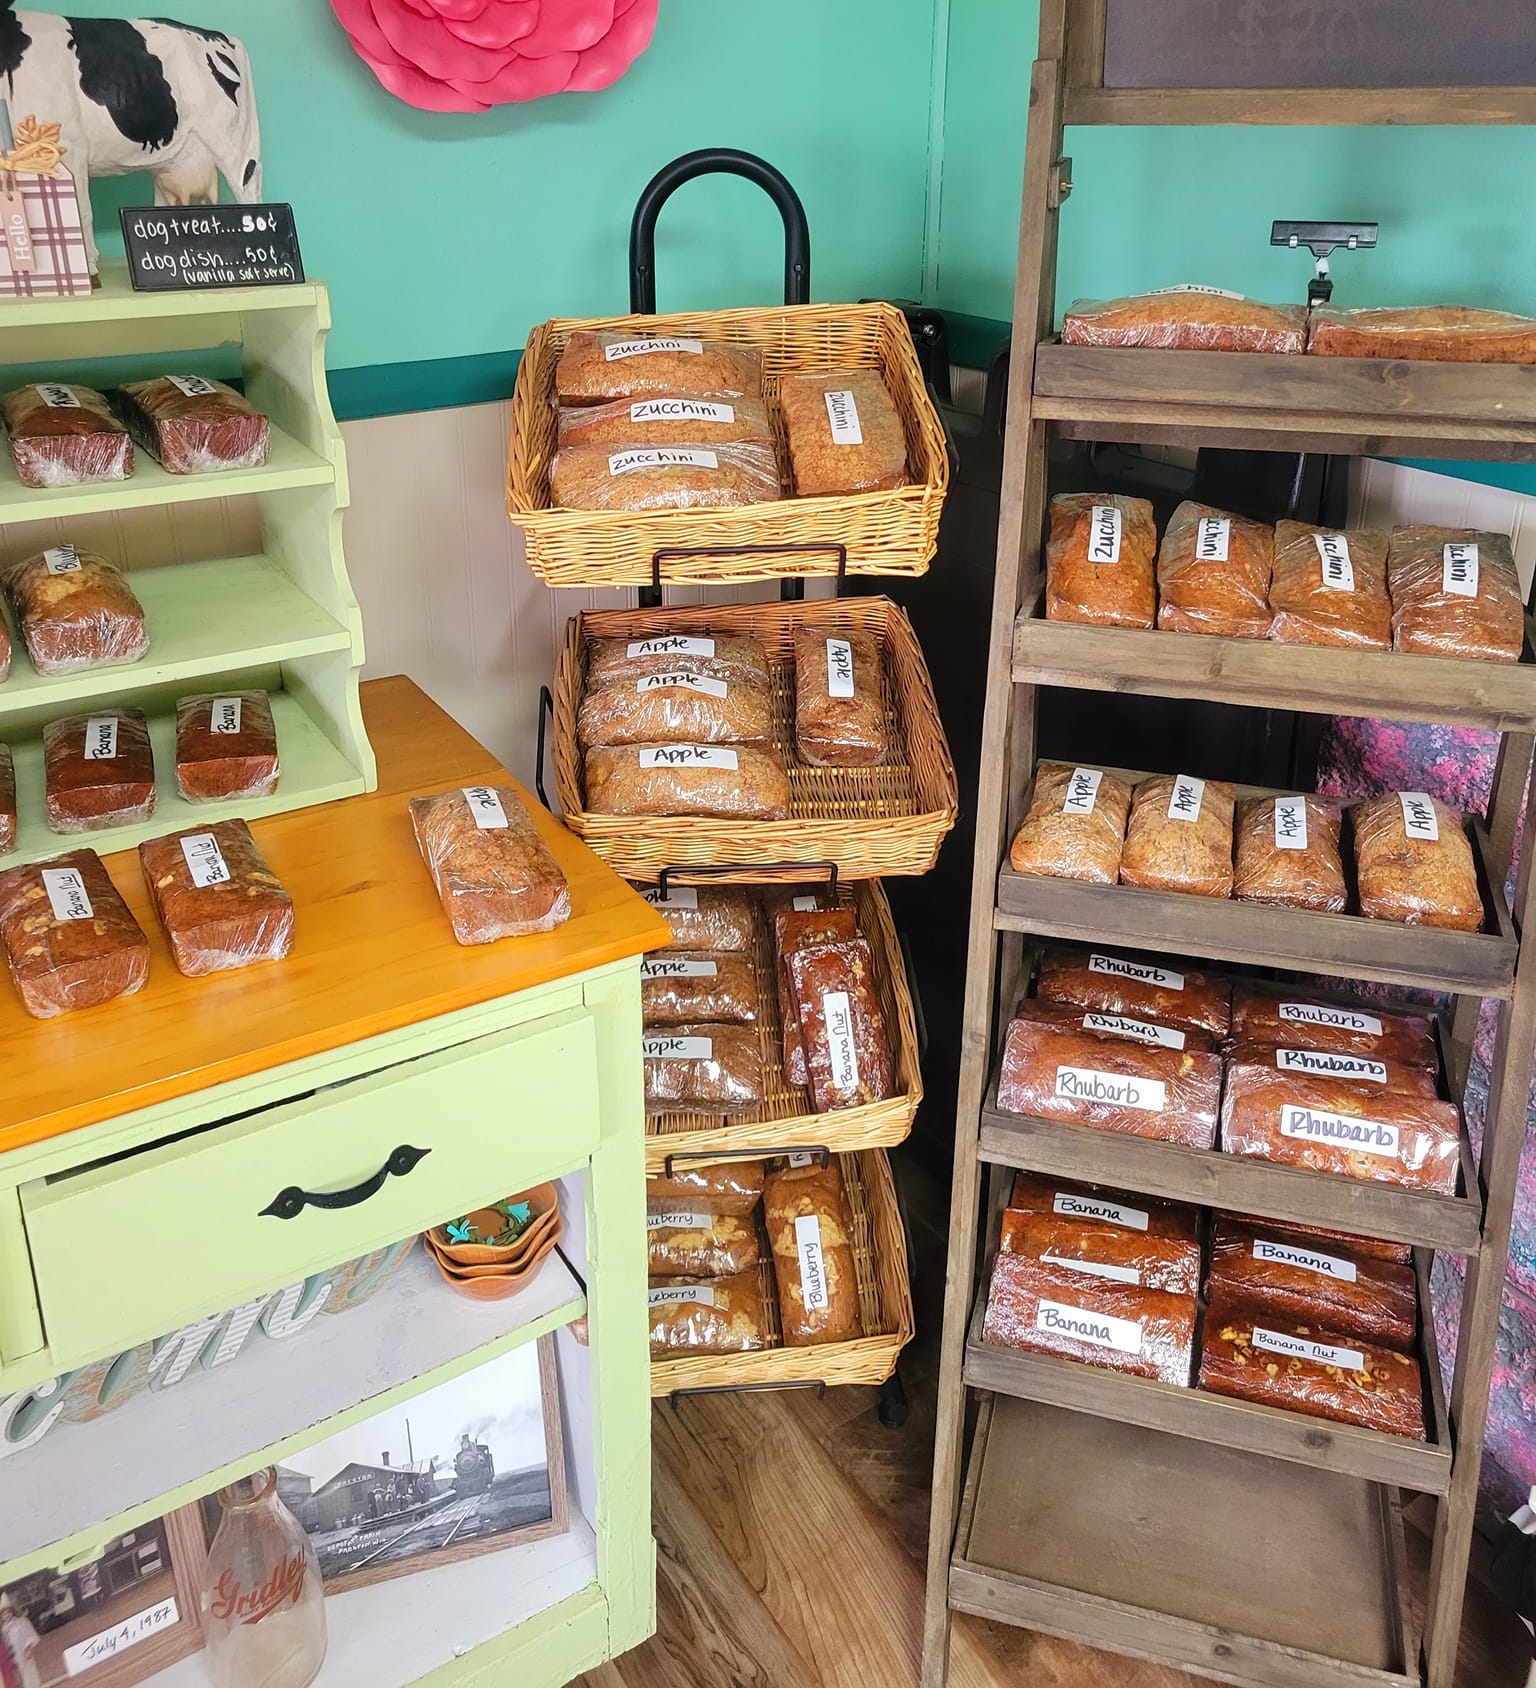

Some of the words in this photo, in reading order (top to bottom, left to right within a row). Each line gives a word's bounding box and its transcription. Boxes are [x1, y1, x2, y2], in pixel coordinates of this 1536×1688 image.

[9, 214, 31, 261] Hello
[134, 218, 169, 245] dog
[141, 252, 177, 277] dog
[1095, 506, 1116, 558] Zucchin
[639, 637, 690, 653] Apple
[830, 645, 851, 679] Apple
[647, 674, 703, 688] Apple
[653, 747, 712, 763] Apple
[1068, 774, 1094, 807] Apple
[1278, 806, 1303, 838] Apple
[640, 961, 688, 976] Apple
[1090, 956, 1166, 982] Rhubarb
[1282, 1005, 1366, 1029] Rhubarb
[839, 1038, 854, 1090] Banana
[1285, 1051, 1385, 1076] Rhubarb
[1057, 1071, 1141, 1105] Rhubarb
[1288, 1110, 1395, 1148] Rhubarb
[1055, 1197, 1124, 1222] Banana
[805, 1242, 824, 1308] Blueberry
[1254, 1244, 1336, 1275] Banana
[648, 1289, 697, 1304] ueberry
[1039, 1308, 1113, 1344] Banana
[1255, 1332, 1306, 1353] Banana
[1311, 1345, 1338, 1361] Nut
[211, 1545, 307, 1620] Gridley
[81, 1633, 118, 1660] July
[139, 1606, 172, 1631] 1987
